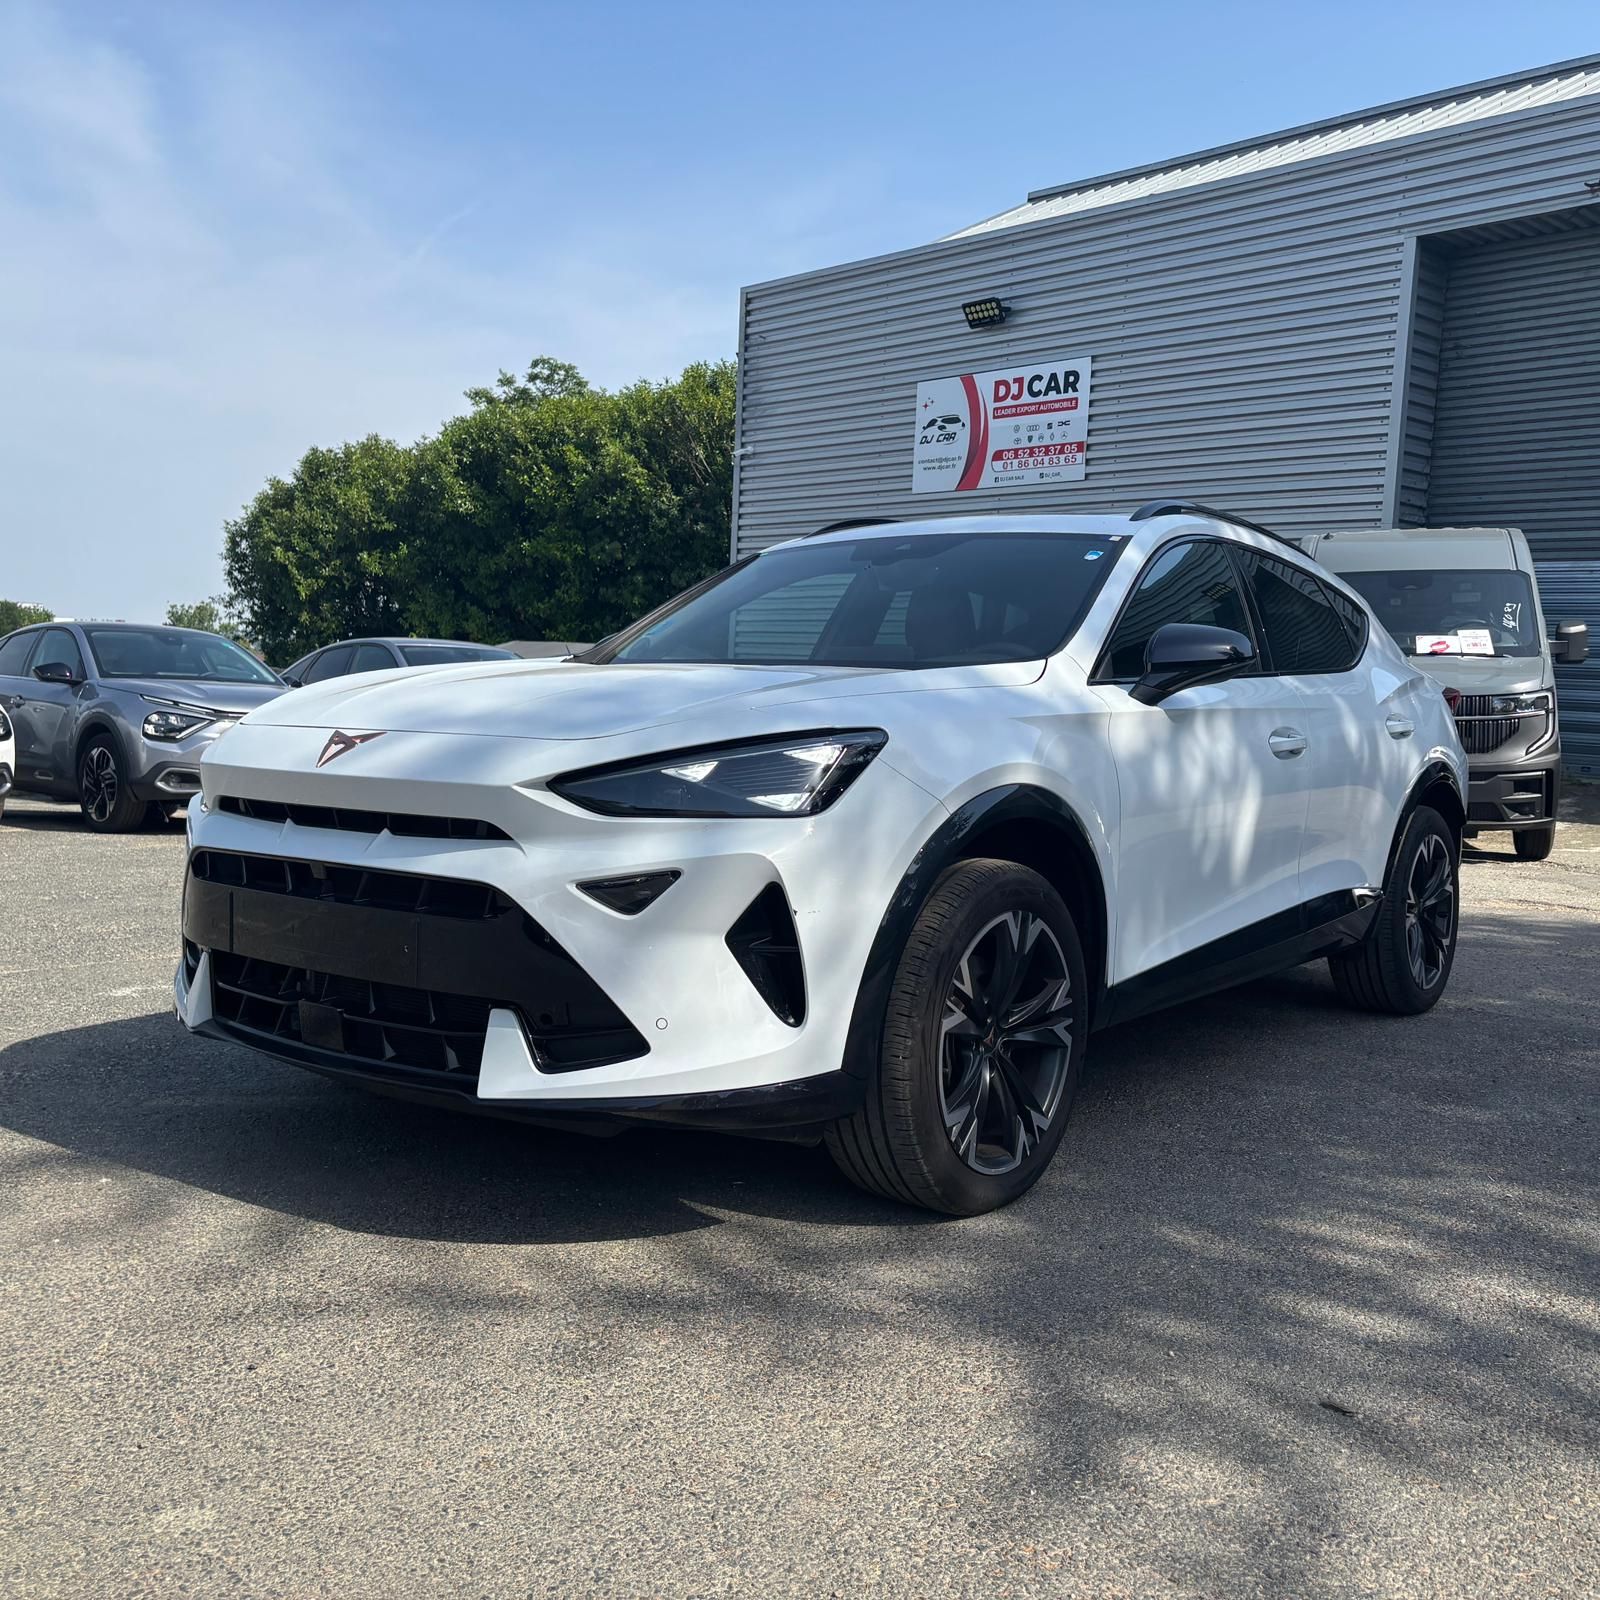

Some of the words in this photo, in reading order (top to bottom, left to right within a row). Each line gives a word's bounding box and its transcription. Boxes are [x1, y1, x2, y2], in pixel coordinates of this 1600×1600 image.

[994, 407, 1017, 417] LEADER
[1017, 404, 1039, 414] EXPORT
[1039, 400, 1077, 411] AUTOMOBILE
[919, 434, 935, 445] DJ
[936, 431, 957, 443] CAR
[1002, 450, 1015, 460] 06
[1017, 449, 1030, 459] 52
[1033, 447, 1046, 457] 32
[1048, 445, 1061, 456] 37
[1064, 444, 1078, 454] 05
[1002, 461, 1014, 470] 01
[1017, 460, 1030, 469] 86
[1032, 458, 1046, 467] 04
[1048, 456, 1061, 466] 83
[1064, 454, 1077, 465] 65
